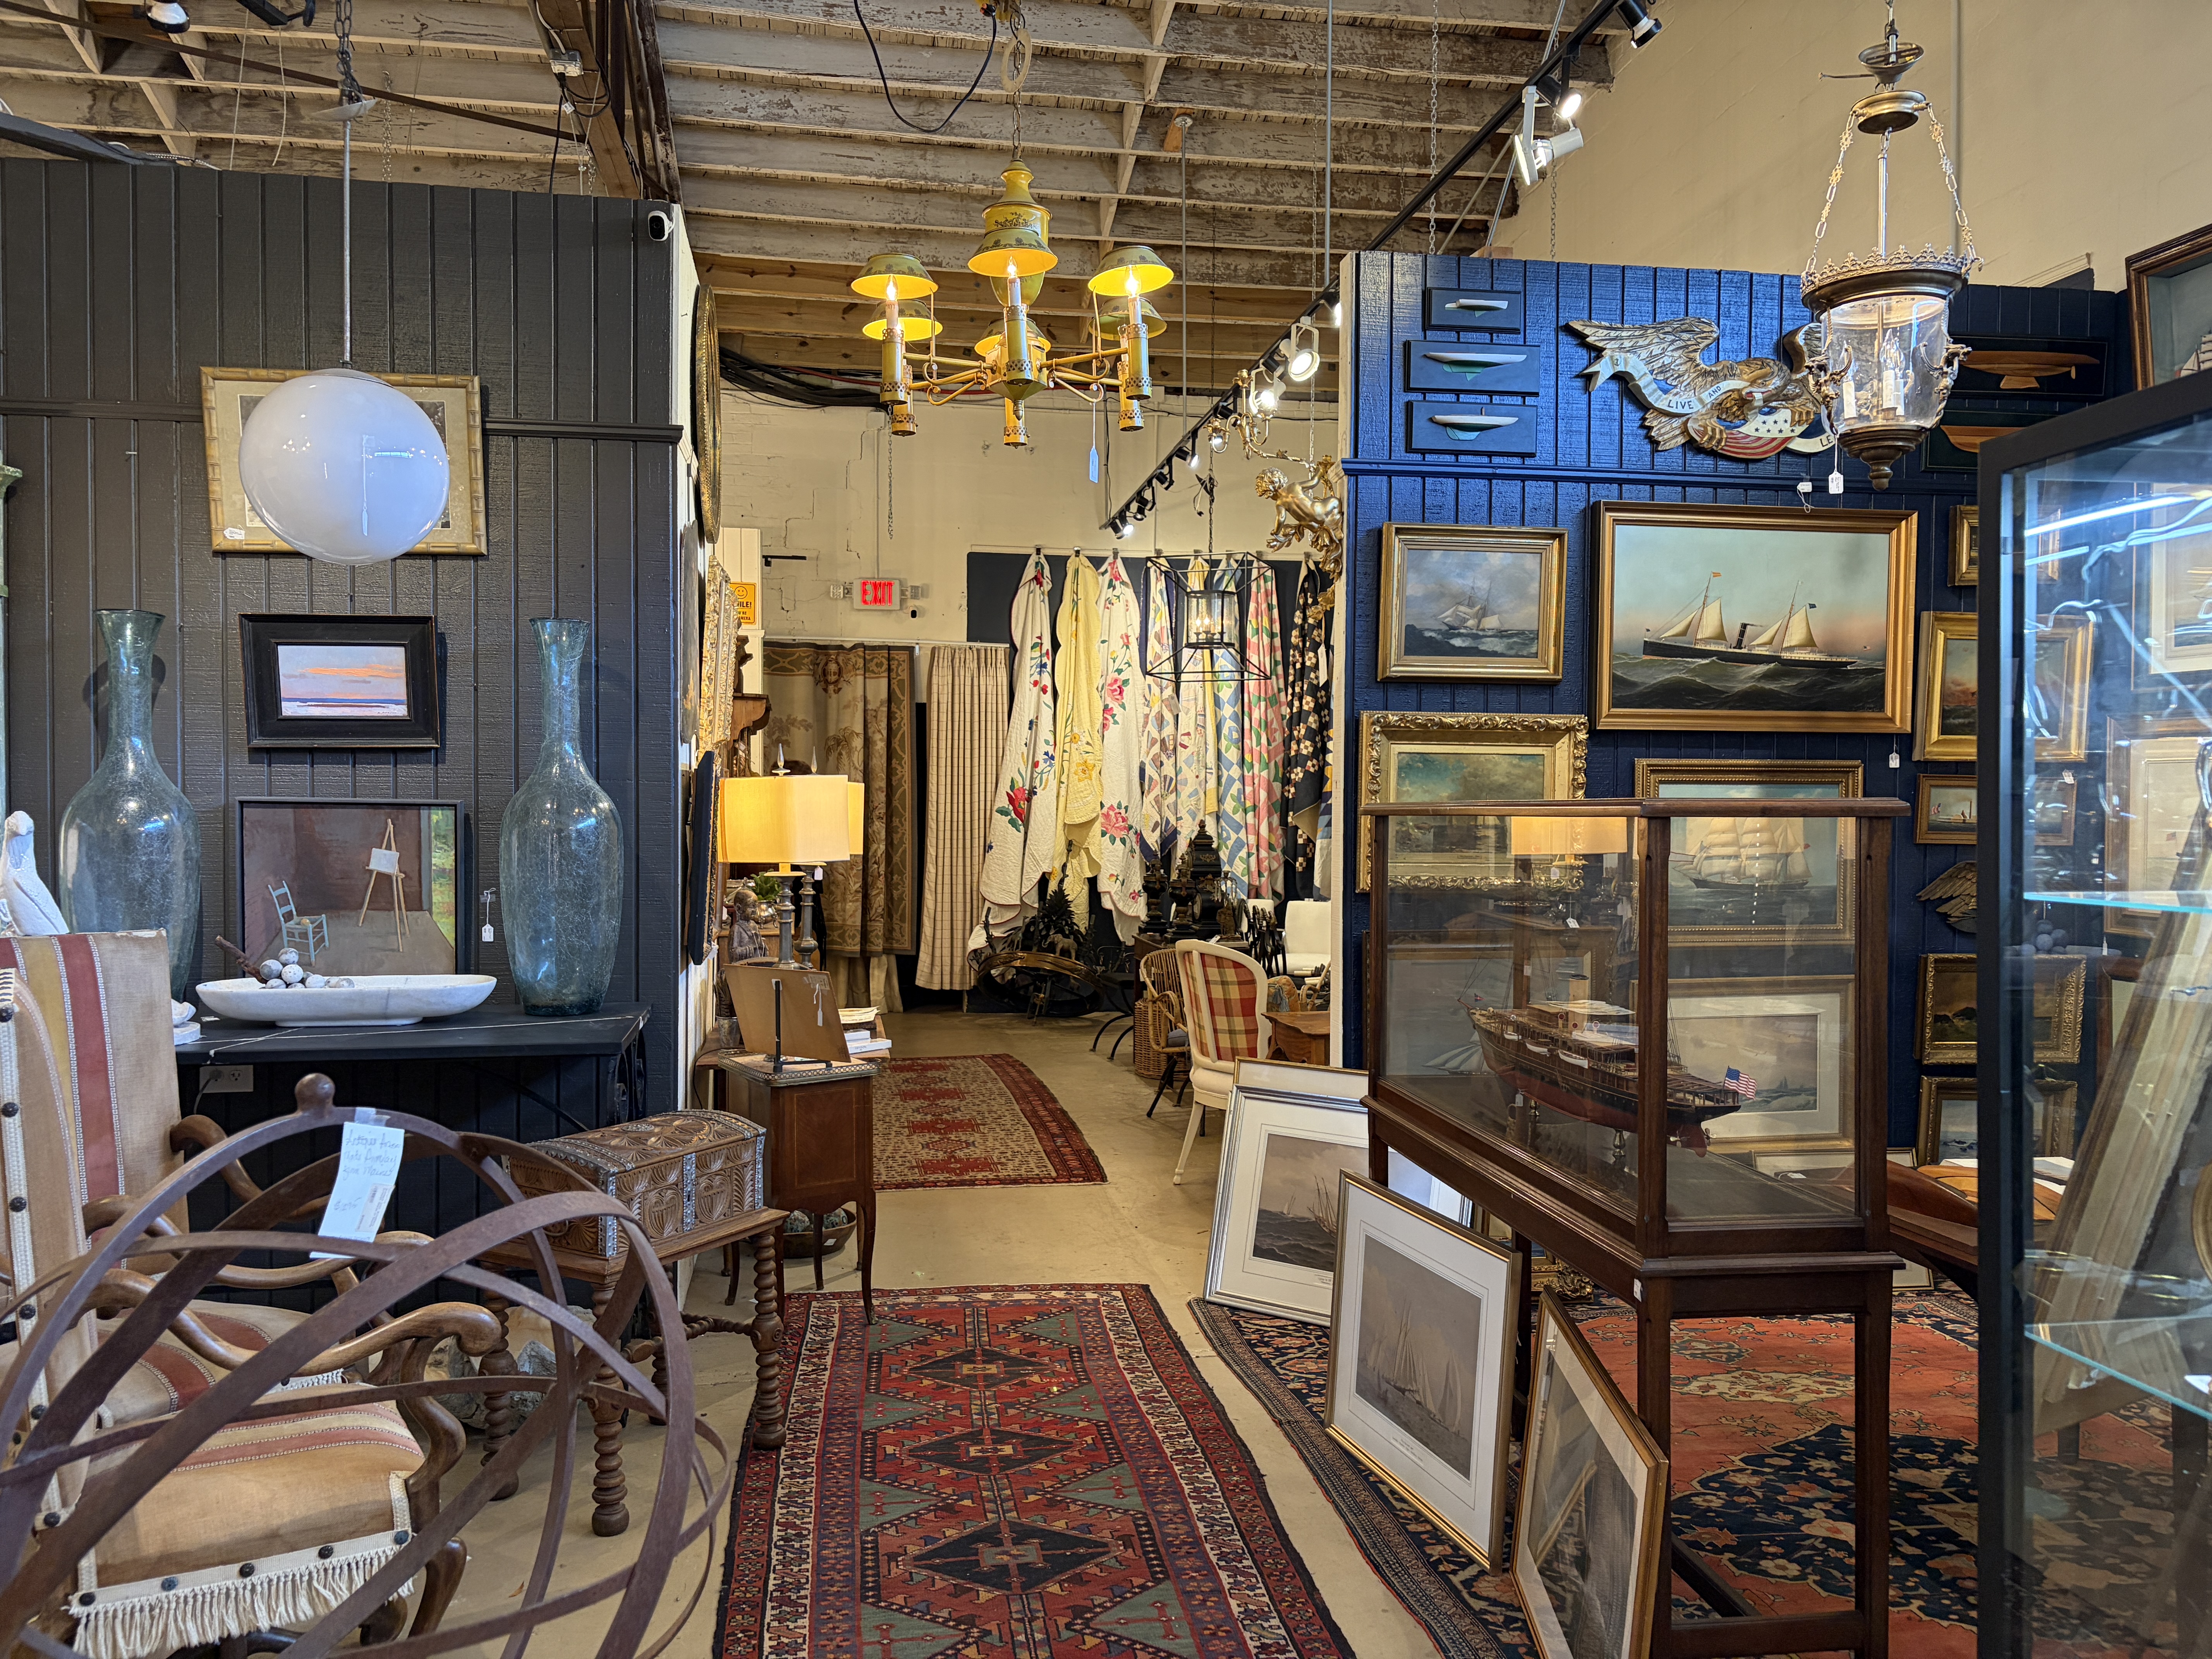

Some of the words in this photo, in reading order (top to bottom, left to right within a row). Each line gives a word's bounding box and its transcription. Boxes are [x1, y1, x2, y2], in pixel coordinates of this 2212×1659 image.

[1668, 400, 1694, 409] LIVE
[1708, 386, 1721, 398] AND
[1820, 434, 1834, 447] LE
[861, 580, 895, 606] EXIT
